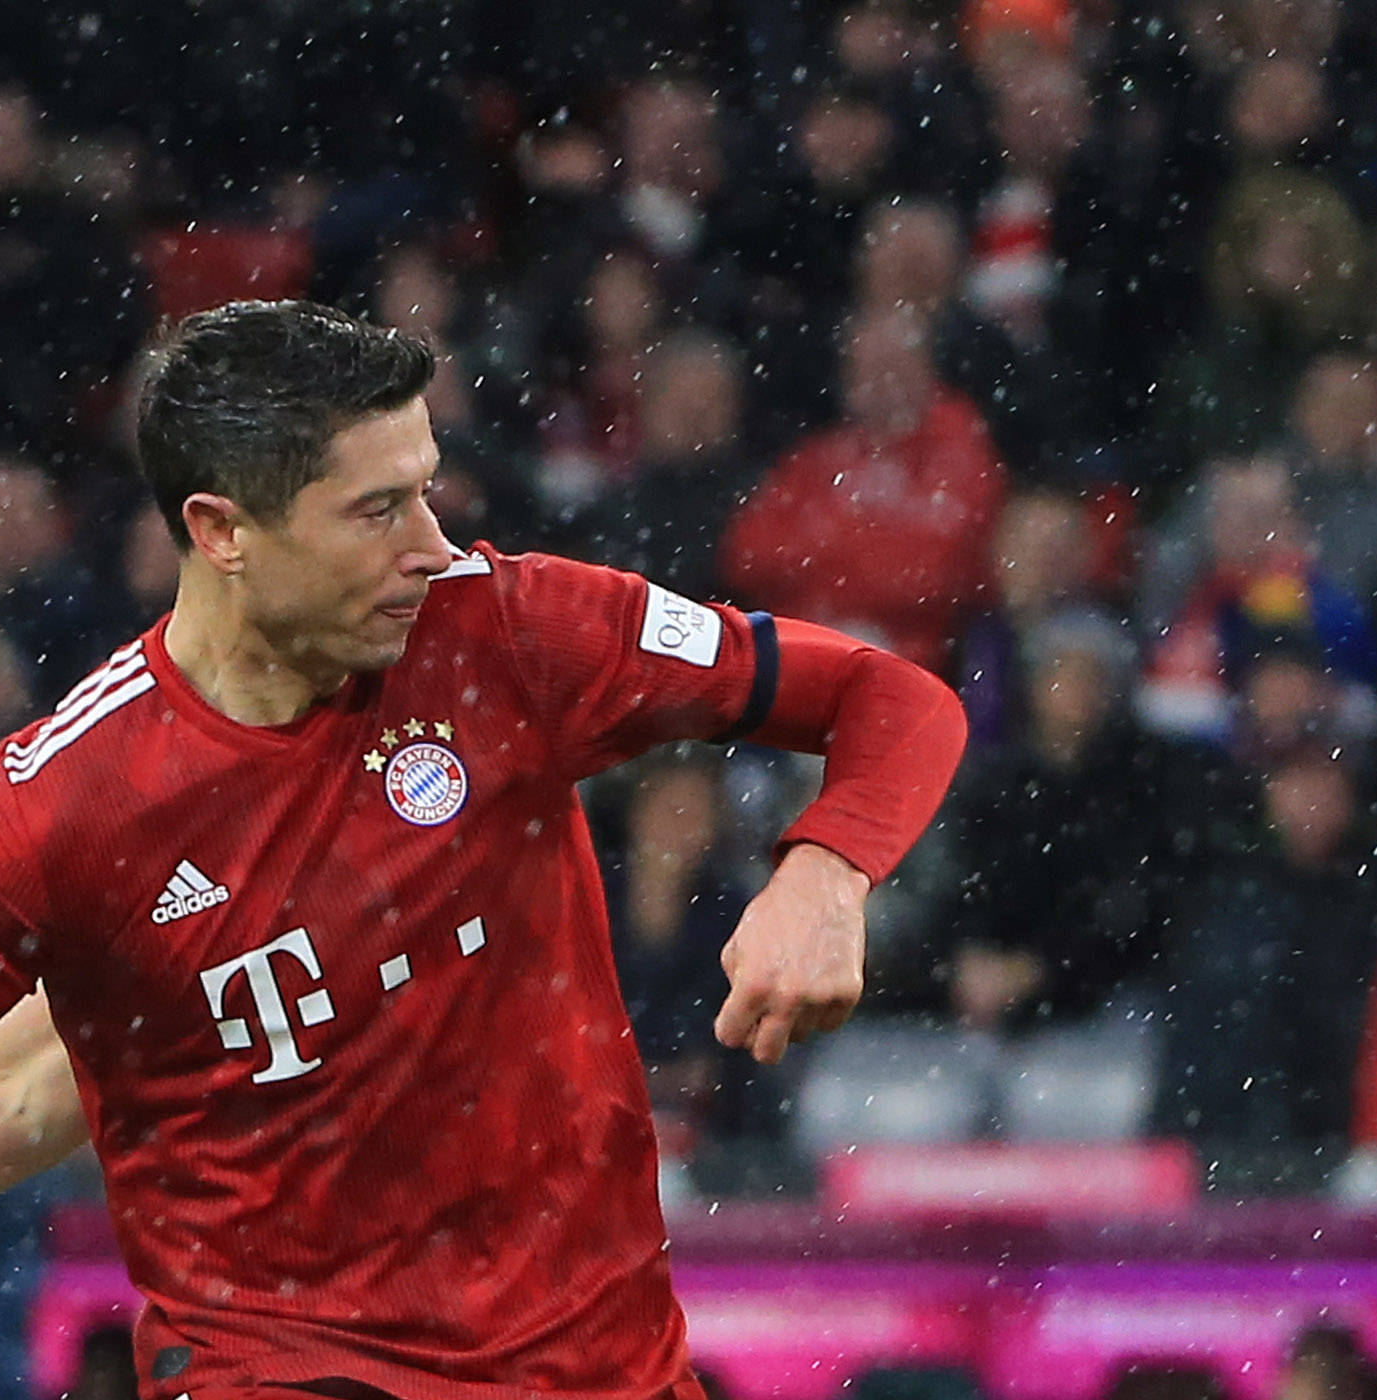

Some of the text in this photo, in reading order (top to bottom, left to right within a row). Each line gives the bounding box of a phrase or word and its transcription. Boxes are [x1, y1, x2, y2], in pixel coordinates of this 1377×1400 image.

[658, 594, 691, 649] QAT
[396, 749, 453, 769] BAYERN
[151, 885, 229, 924] adidas
